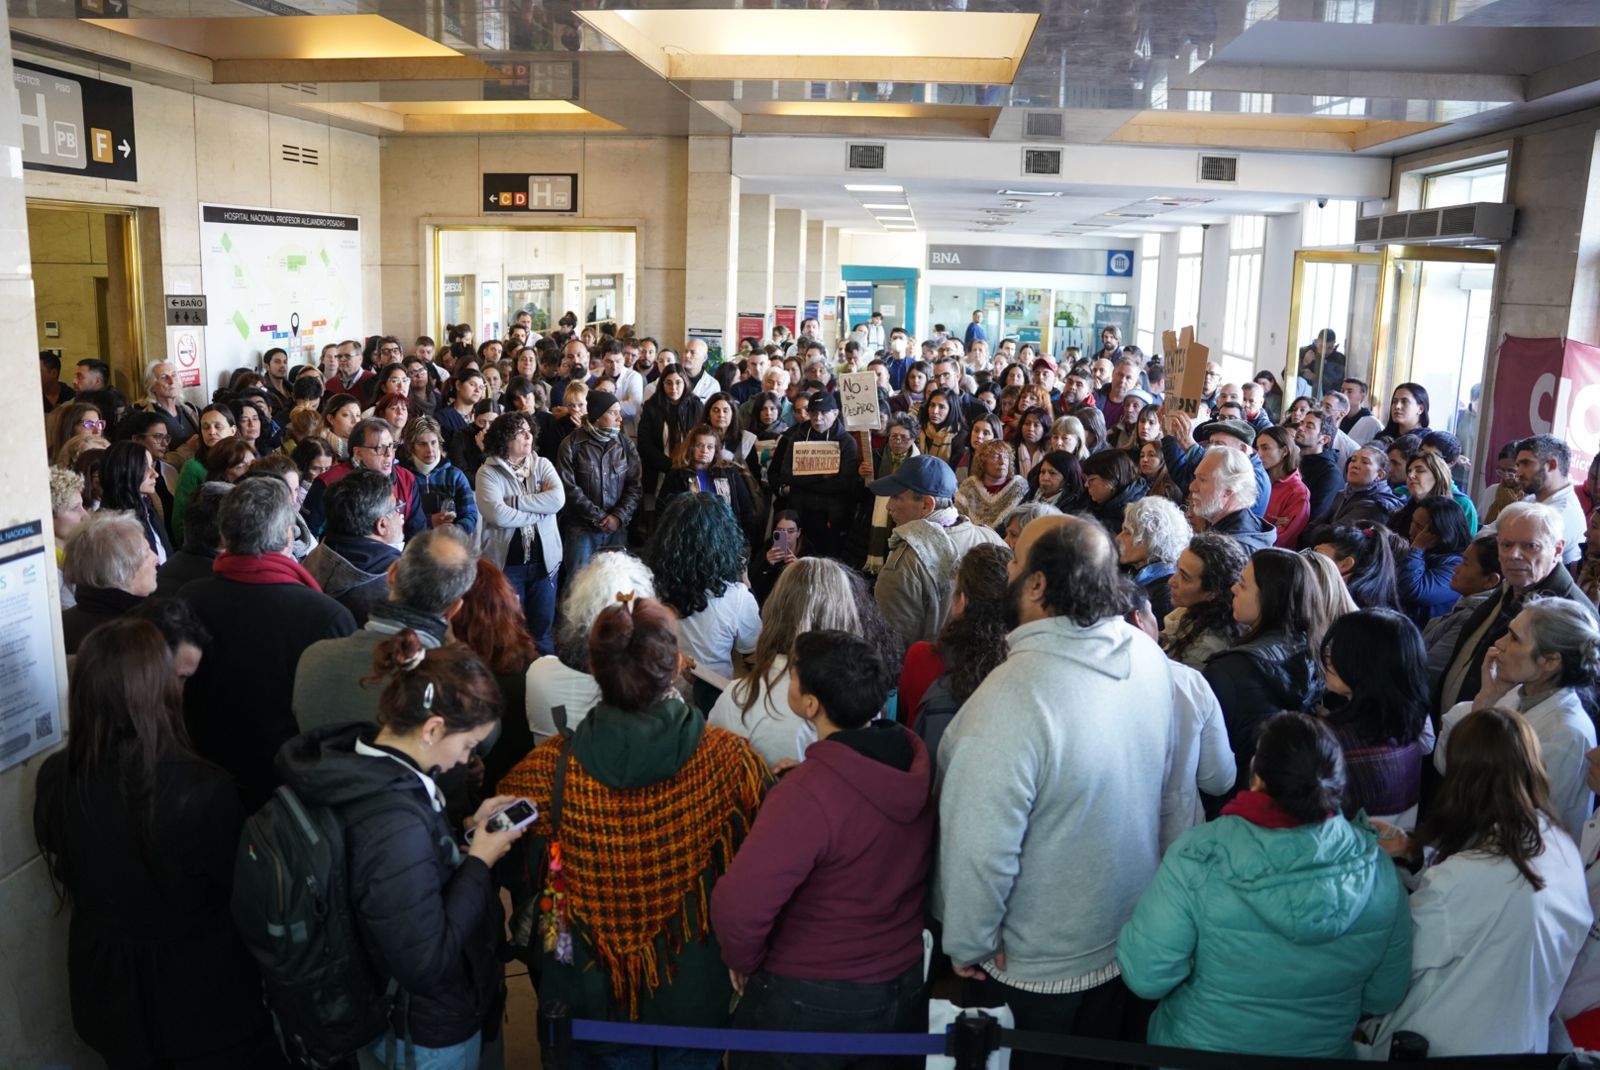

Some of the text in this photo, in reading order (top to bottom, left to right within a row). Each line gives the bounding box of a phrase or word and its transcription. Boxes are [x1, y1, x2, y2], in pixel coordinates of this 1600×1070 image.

[57, 131, 75, 148] PB
[96, 132, 108, 158] F
[501, 193, 511, 205] C
[515, 193, 525, 205] D
[533, 183, 552, 206] H
[224, 211, 250, 222] HOSPITAL
[250, 213, 276, 224] NACIONAL
[276, 215, 301, 225] PROFESOR
[301, 217, 326, 227] ALEJANDRO
[931, 252, 961, 264] BNA
[180, 298, 203, 308] BAÑO
[843, 378, 861, 394] NO
